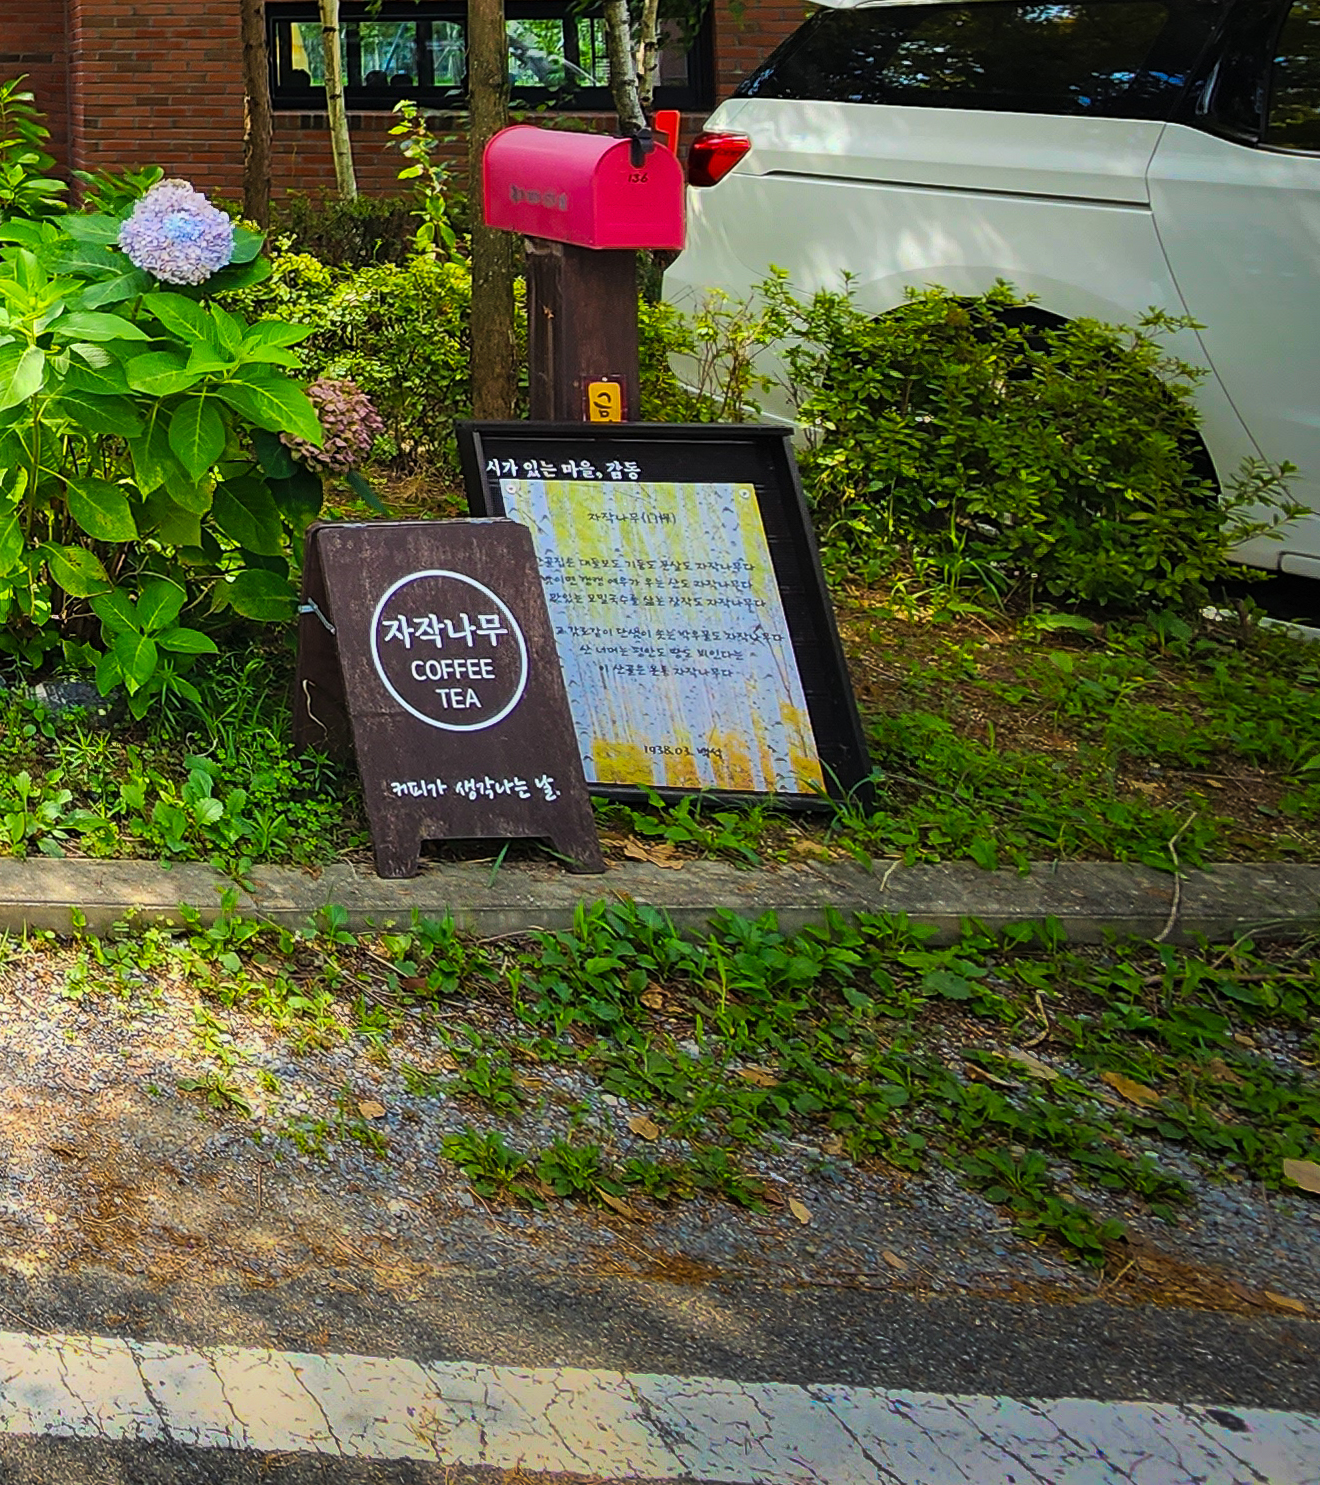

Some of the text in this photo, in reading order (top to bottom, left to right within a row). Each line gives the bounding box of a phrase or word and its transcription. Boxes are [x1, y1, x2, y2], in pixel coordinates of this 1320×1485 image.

[628, 173, 649, 183] 136
[486, 458, 641, 480] 시가 있는 마을, 감동
[382, 613, 508, 649] 자작나무
[411, 659, 495, 681] COFFEE
[435, 688, 482, 709] TEA
[391, 778, 447, 798] 커피가
[456, 776, 531, 800] 생각나는
